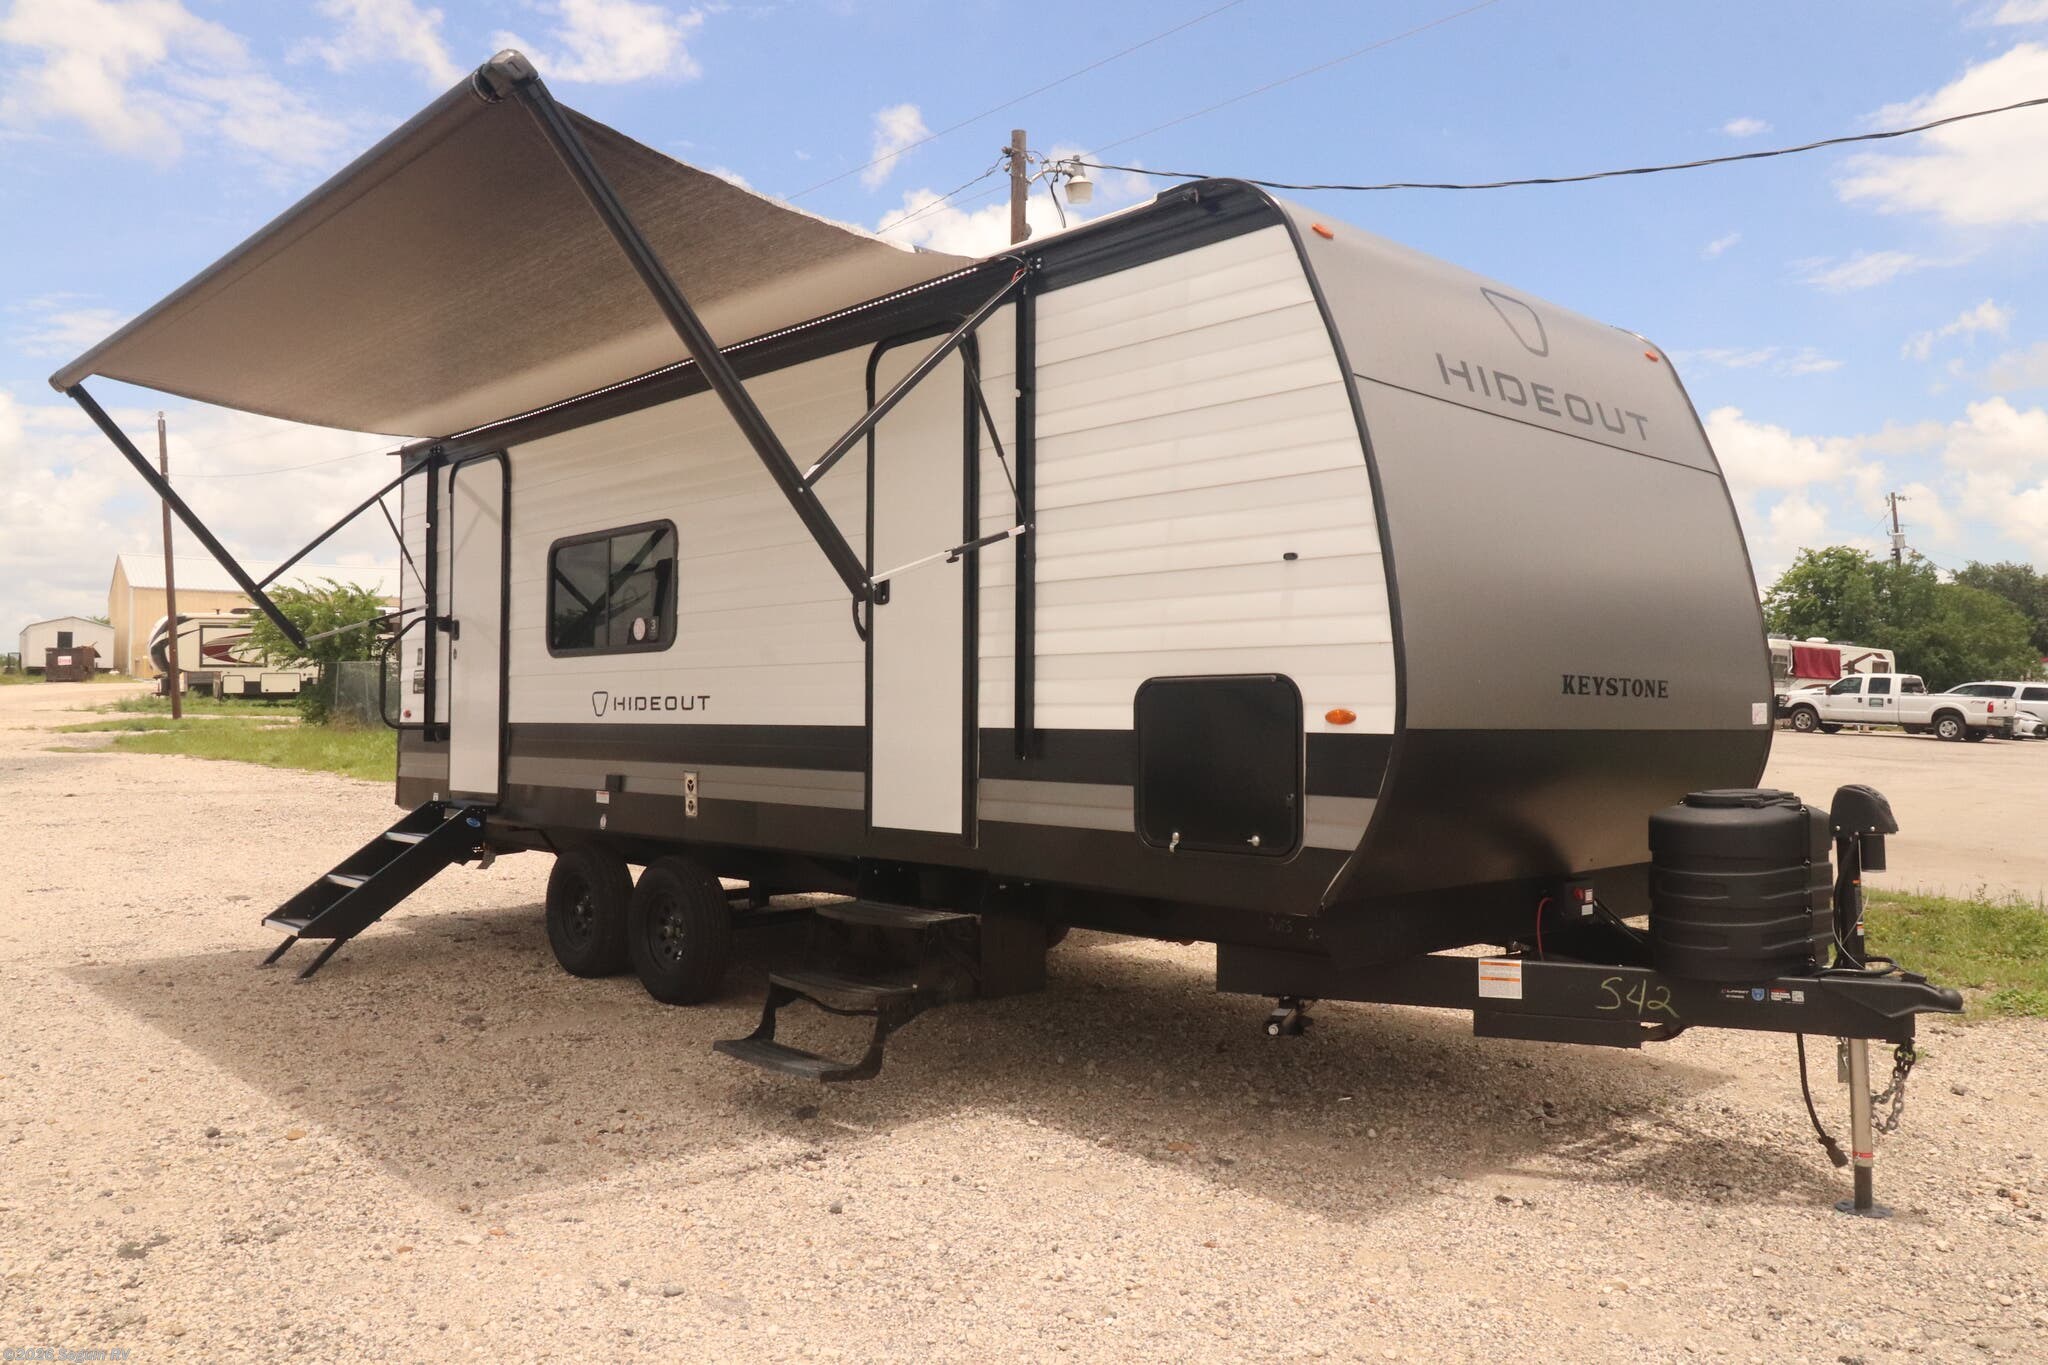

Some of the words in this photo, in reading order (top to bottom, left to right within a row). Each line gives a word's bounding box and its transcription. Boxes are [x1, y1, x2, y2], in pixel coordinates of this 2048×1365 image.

[1435, 353, 1649, 441] HIDEOUT
[1562, 674, 1669, 699] KEYSTONE
[613, 695, 711, 712] HIDEOUT
